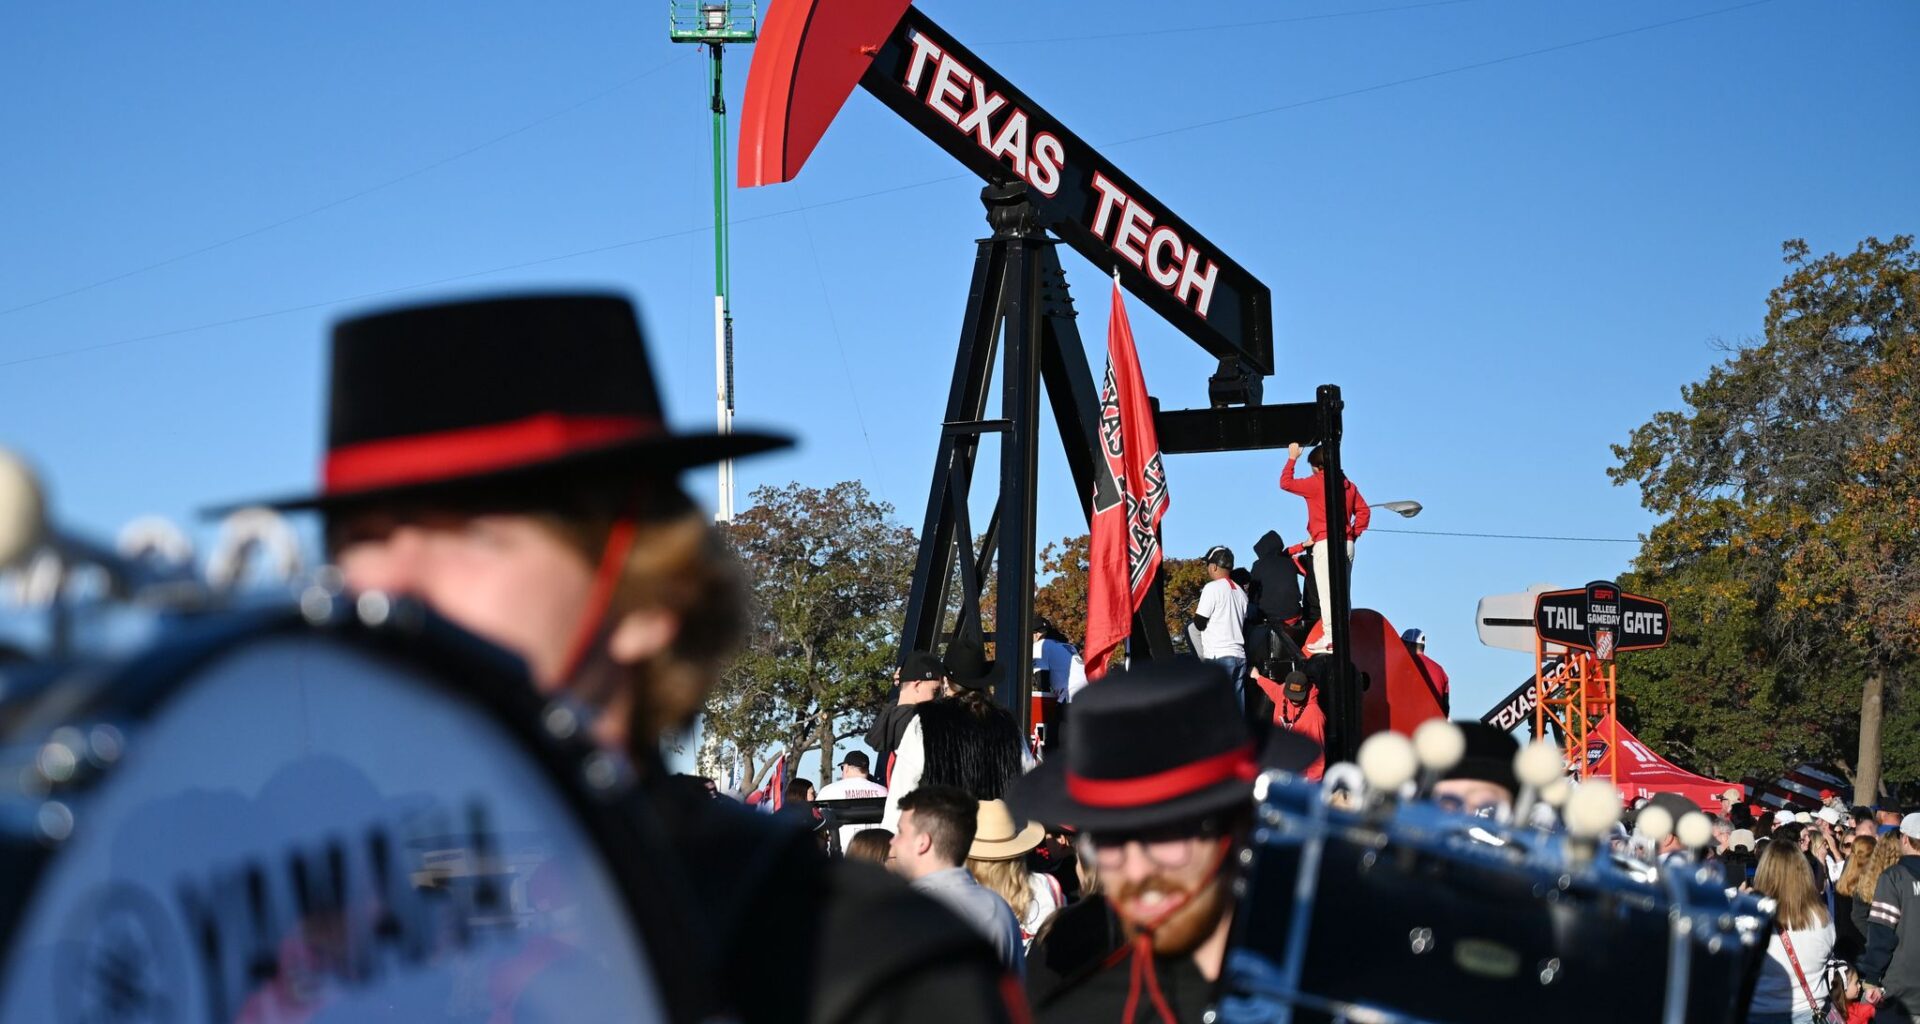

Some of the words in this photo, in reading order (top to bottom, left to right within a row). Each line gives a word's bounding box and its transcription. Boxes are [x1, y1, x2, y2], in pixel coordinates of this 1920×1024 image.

[902, 31, 1065, 197] TEXAS
[1093, 171, 1220, 320] TECH
[1543, 605, 1584, 631] TAIL
[1623, 611, 1663, 635] GATE
[1587, 613, 1620, 625] GAMEDAY
[1591, 604, 1617, 614] COLLEGE
[1488, 686, 1537, 731] TEXAS
